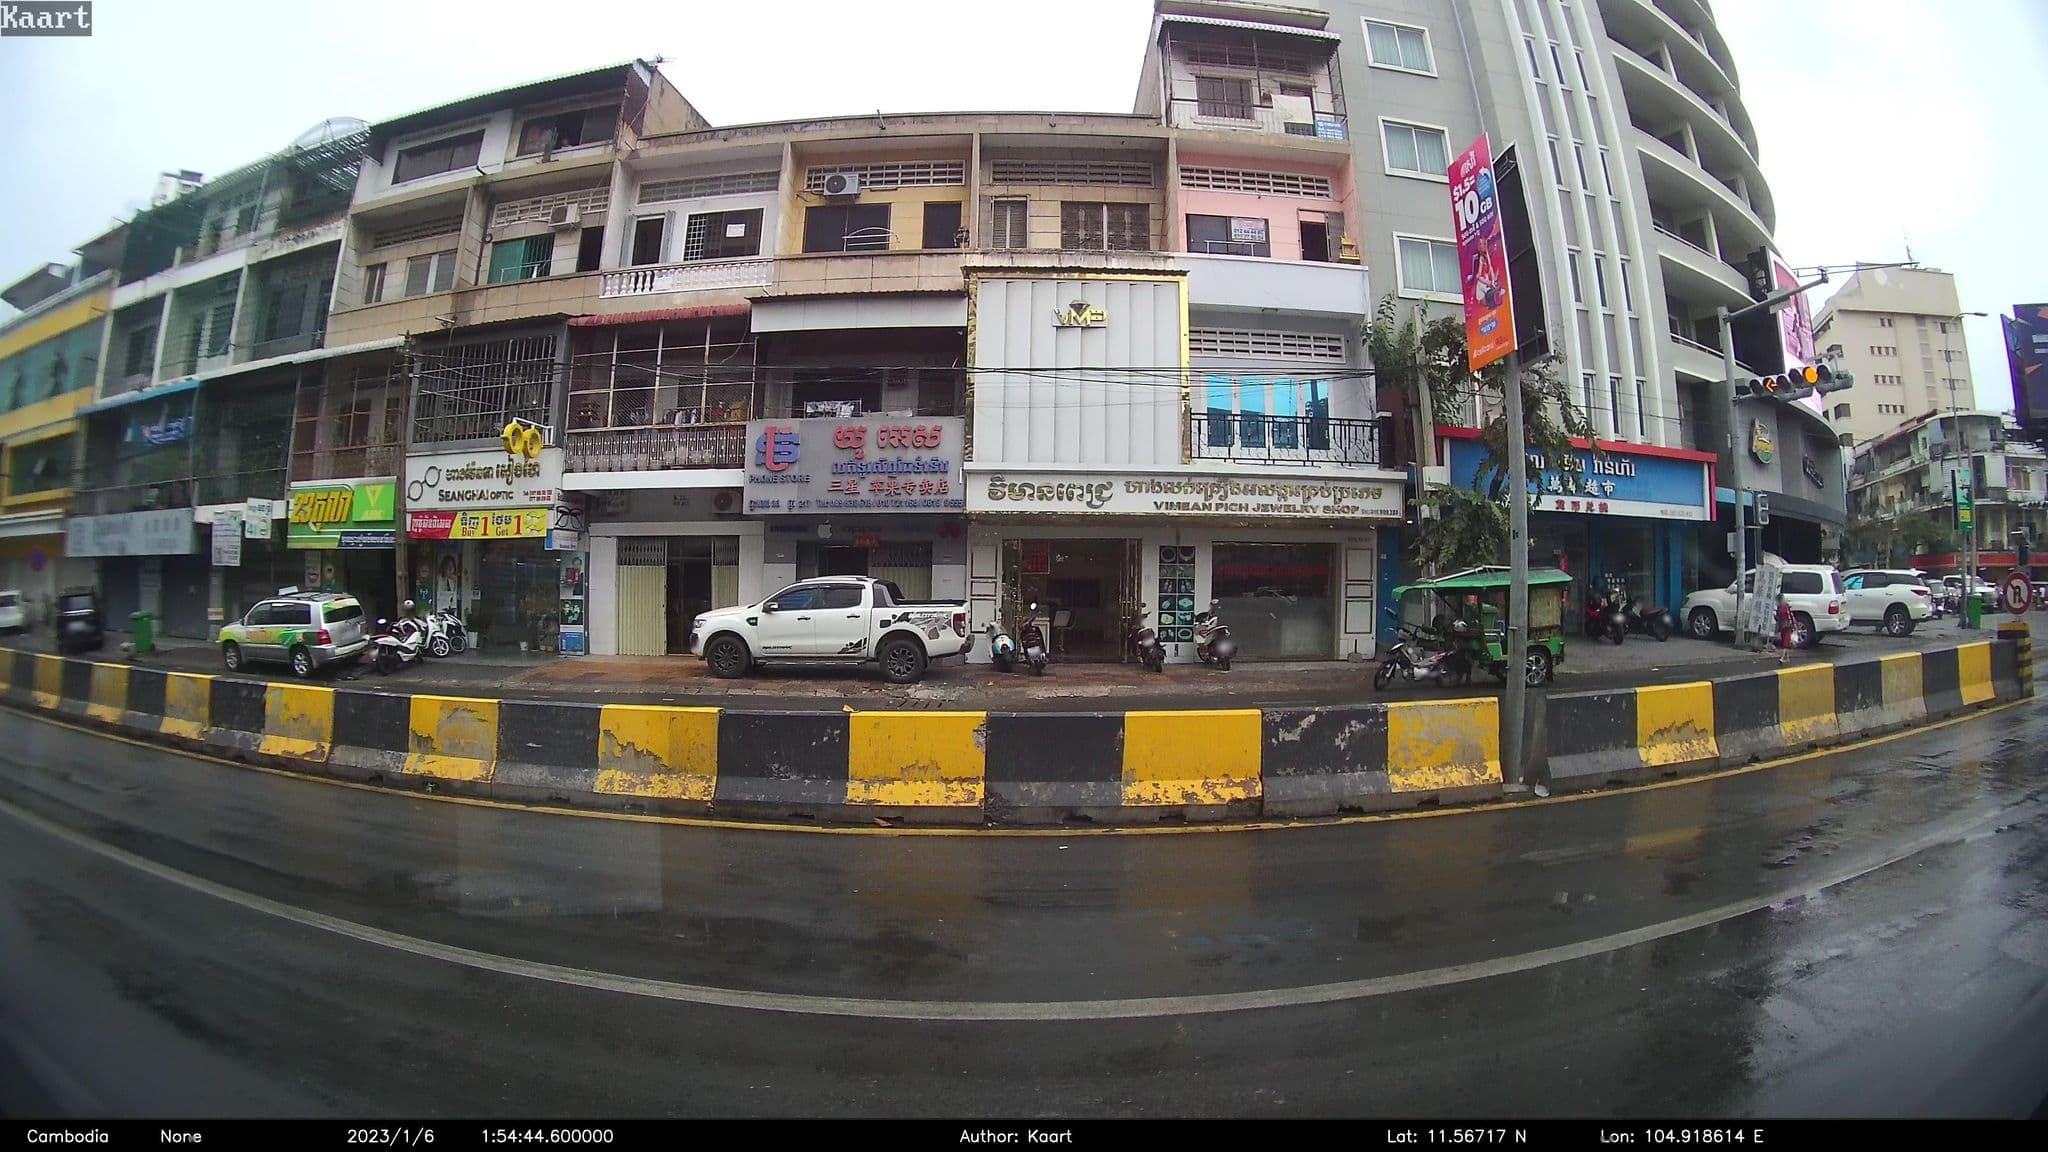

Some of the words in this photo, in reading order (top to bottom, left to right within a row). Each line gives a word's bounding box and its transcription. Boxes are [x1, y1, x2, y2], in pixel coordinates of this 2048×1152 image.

[1455, 190, 1479, 231] 10
[1480, 197, 1492, 213] GB
[833, 425, 868, 459] យូ
[877, 425, 942, 449] អេស
[749, 474, 778, 484] PHONE
[779, 473, 810, 483] STORE
[438, 489, 489, 501] SEANGHAI
[490, 491, 514, 500] OPTIC
[827, 480, 861, 494] 三星
[868, 479, 950, 496] 苹果专卖店
[1153, 501, 1213, 511] VIMEAN
[1215, 502, 1249, 512] PICH
[1322, 504, 1360, 515] SHOP
[461, 527, 475, 537] Buy
[495, 526, 509, 536] Get
[481, 515, 489, 536] 1
[514, 514, 522, 535] 1
